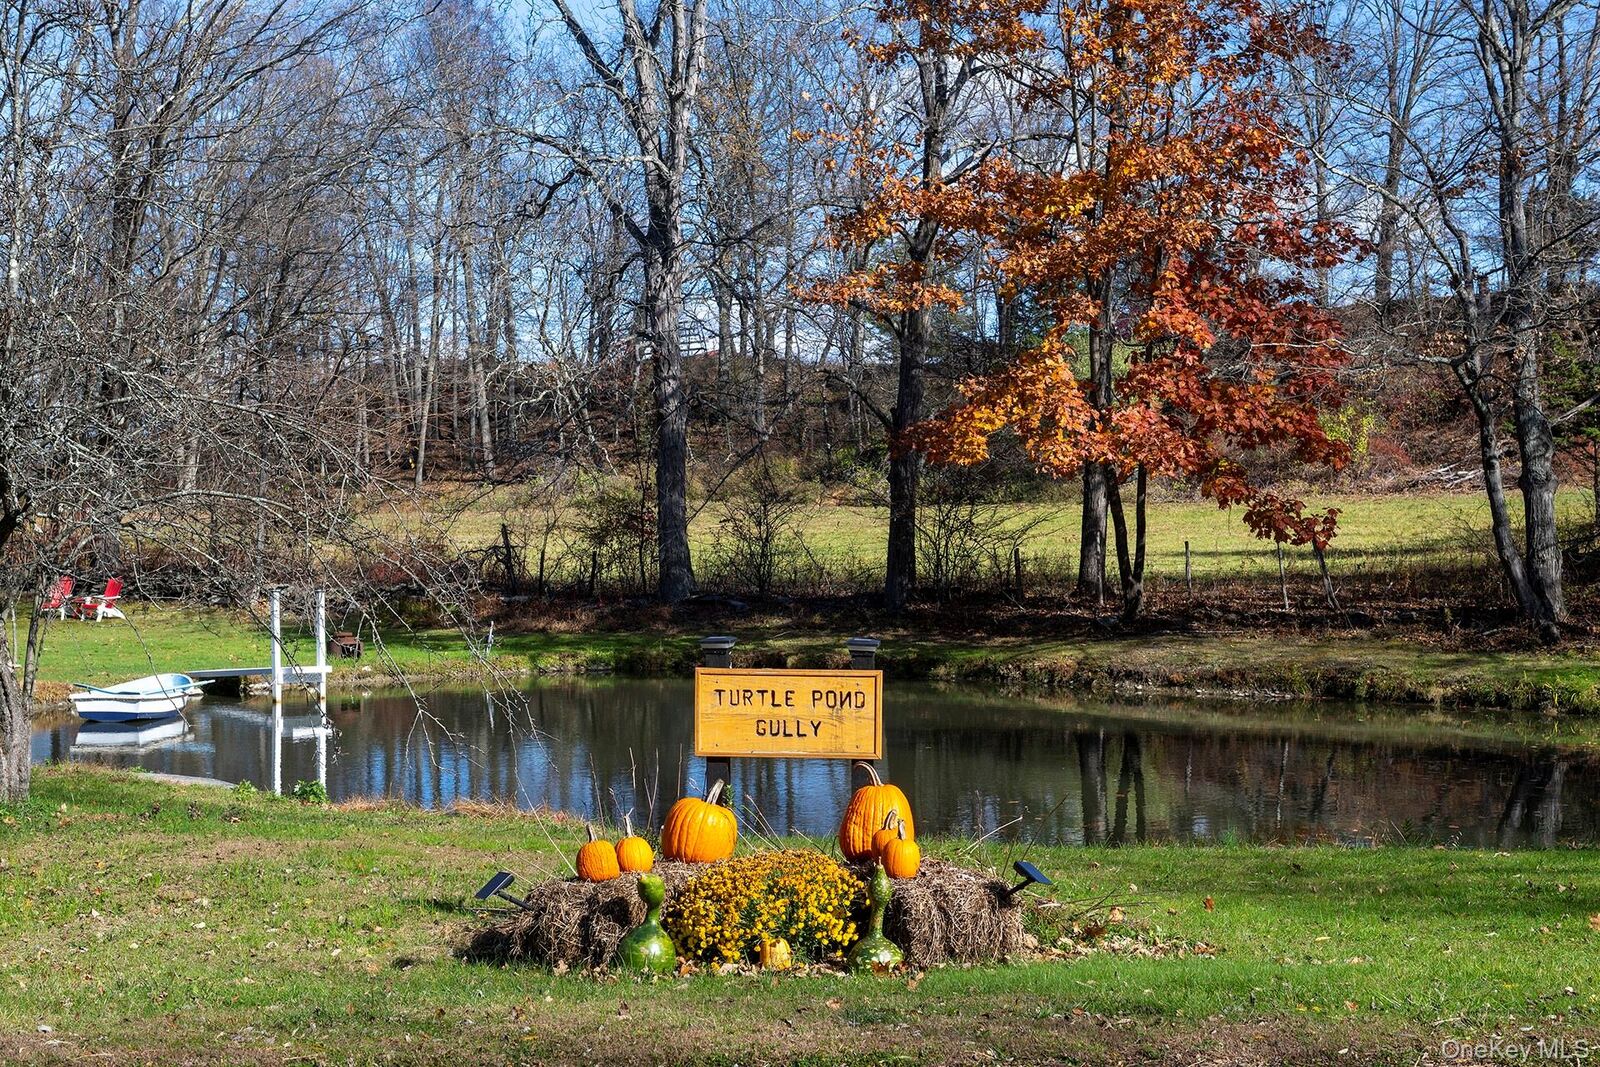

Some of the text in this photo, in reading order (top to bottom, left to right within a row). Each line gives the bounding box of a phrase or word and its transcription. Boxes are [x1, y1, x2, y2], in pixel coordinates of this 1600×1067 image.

[714, 689, 866, 709] TURTLE POND
[756, 719, 821, 737] GULLY
